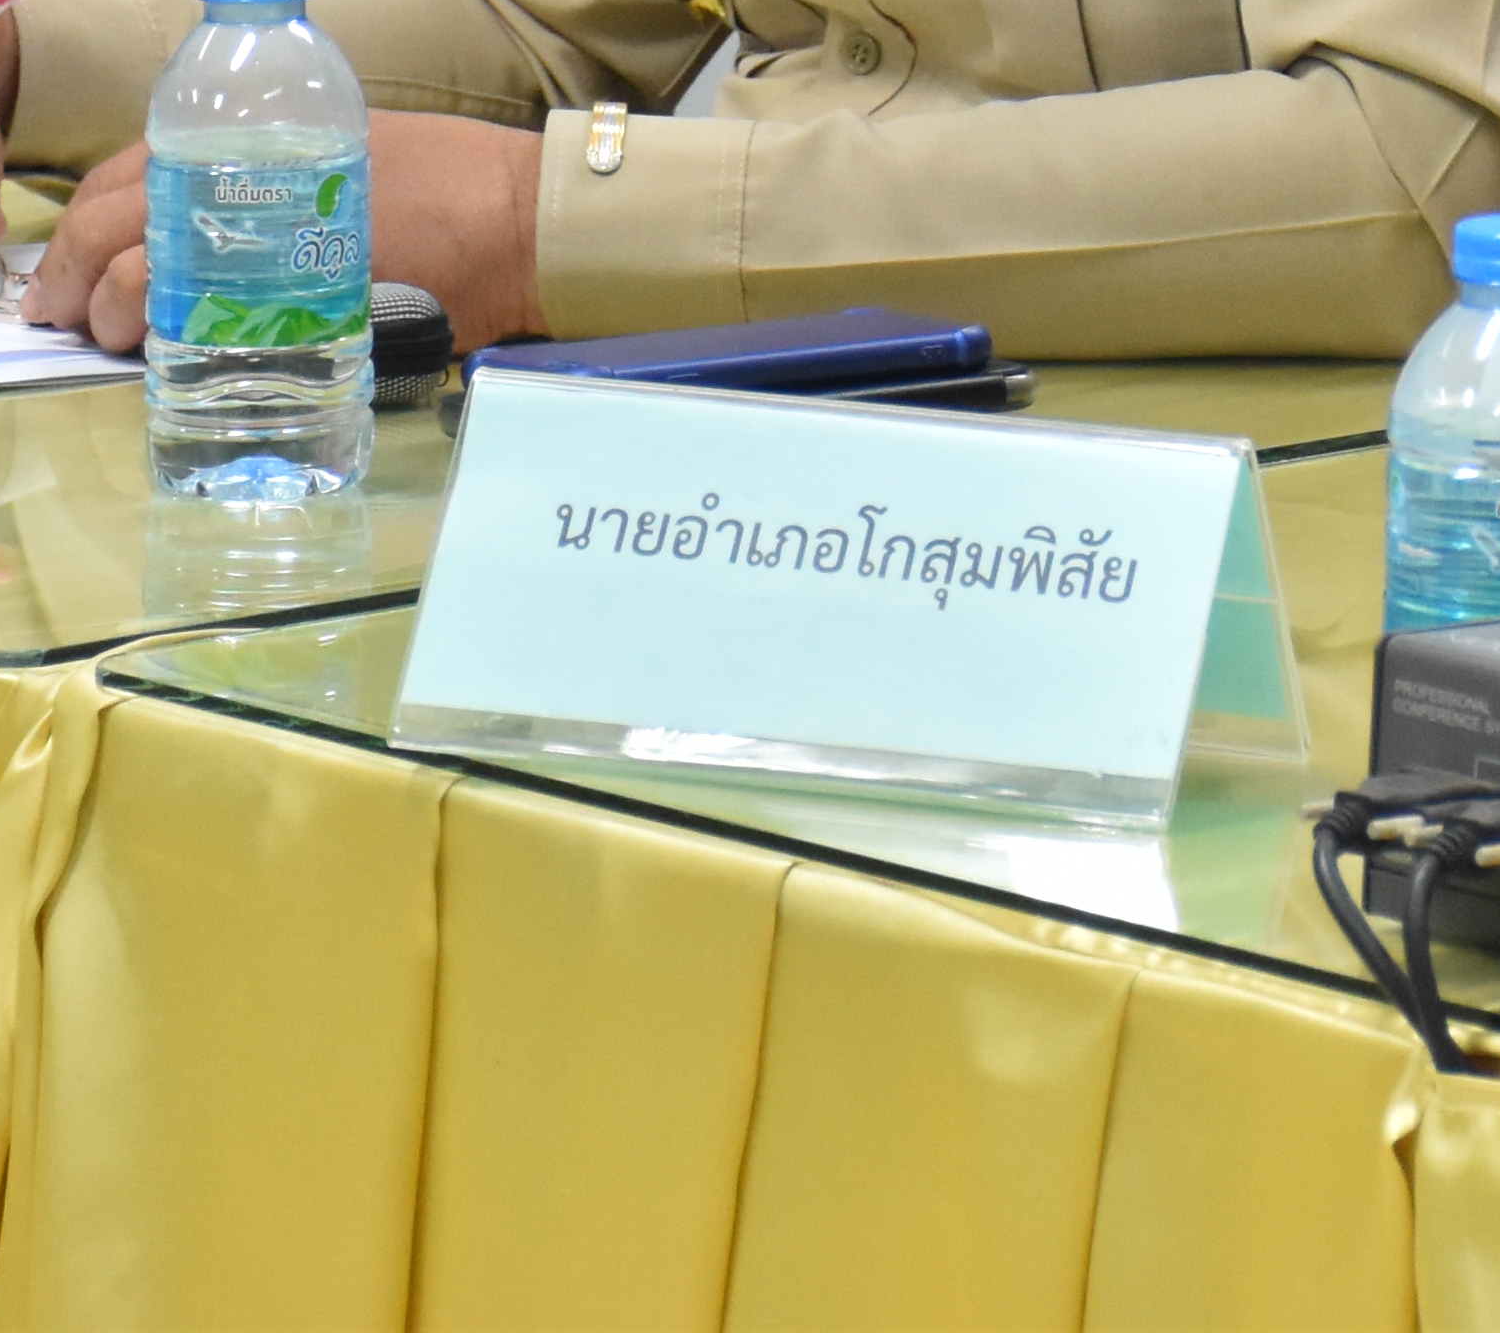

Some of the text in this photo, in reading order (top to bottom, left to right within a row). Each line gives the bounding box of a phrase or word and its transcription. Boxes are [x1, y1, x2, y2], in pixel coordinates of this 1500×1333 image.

[215, 176, 294, 203] น้ำดื่มตรา
[291, 227, 360, 280] ดีคูล
[555, 492, 1140, 611] นายอำเภอโกสุมพิสัย
